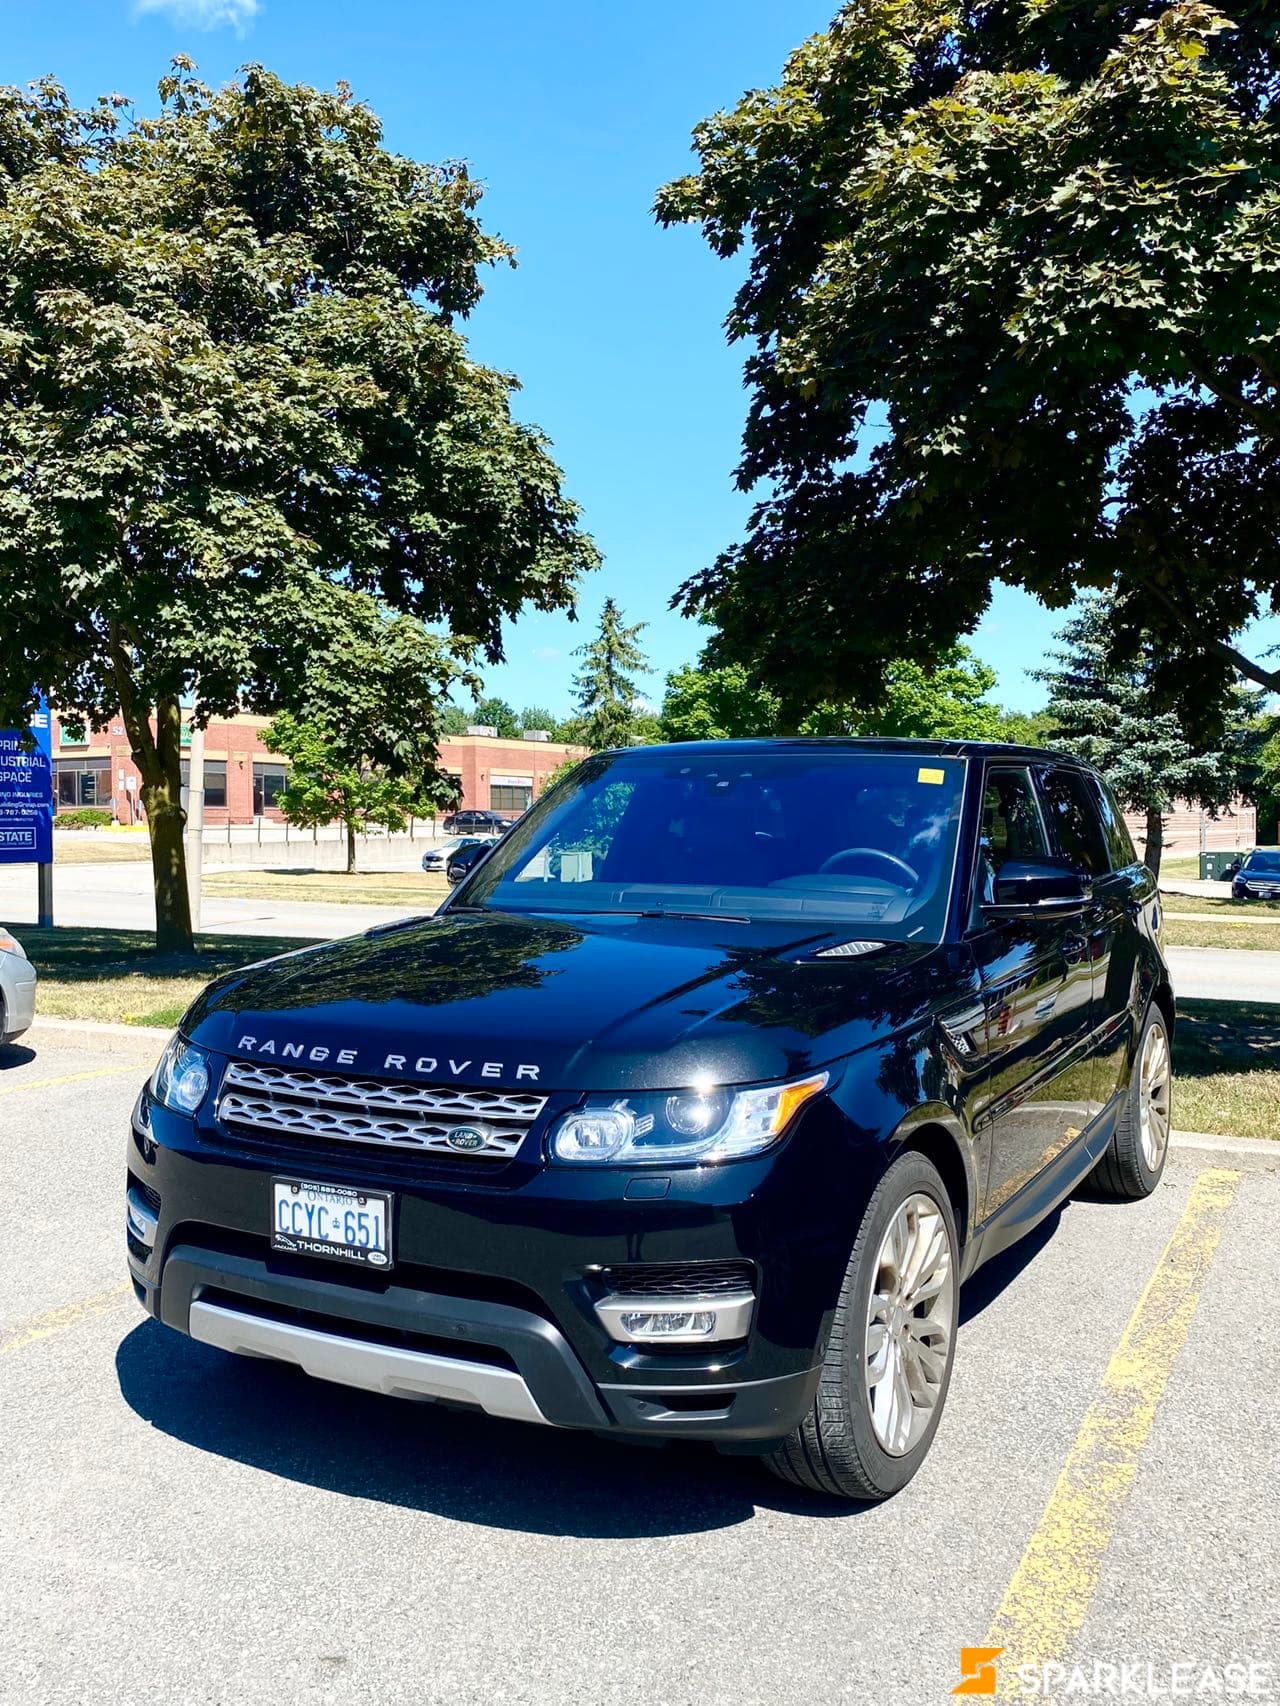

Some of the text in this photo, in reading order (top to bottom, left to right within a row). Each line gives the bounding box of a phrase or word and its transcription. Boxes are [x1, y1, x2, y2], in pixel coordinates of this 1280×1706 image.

[237, 1034, 540, 1081] RANGE ROVER
[296, 1240, 366, 1261] THORNHILL
